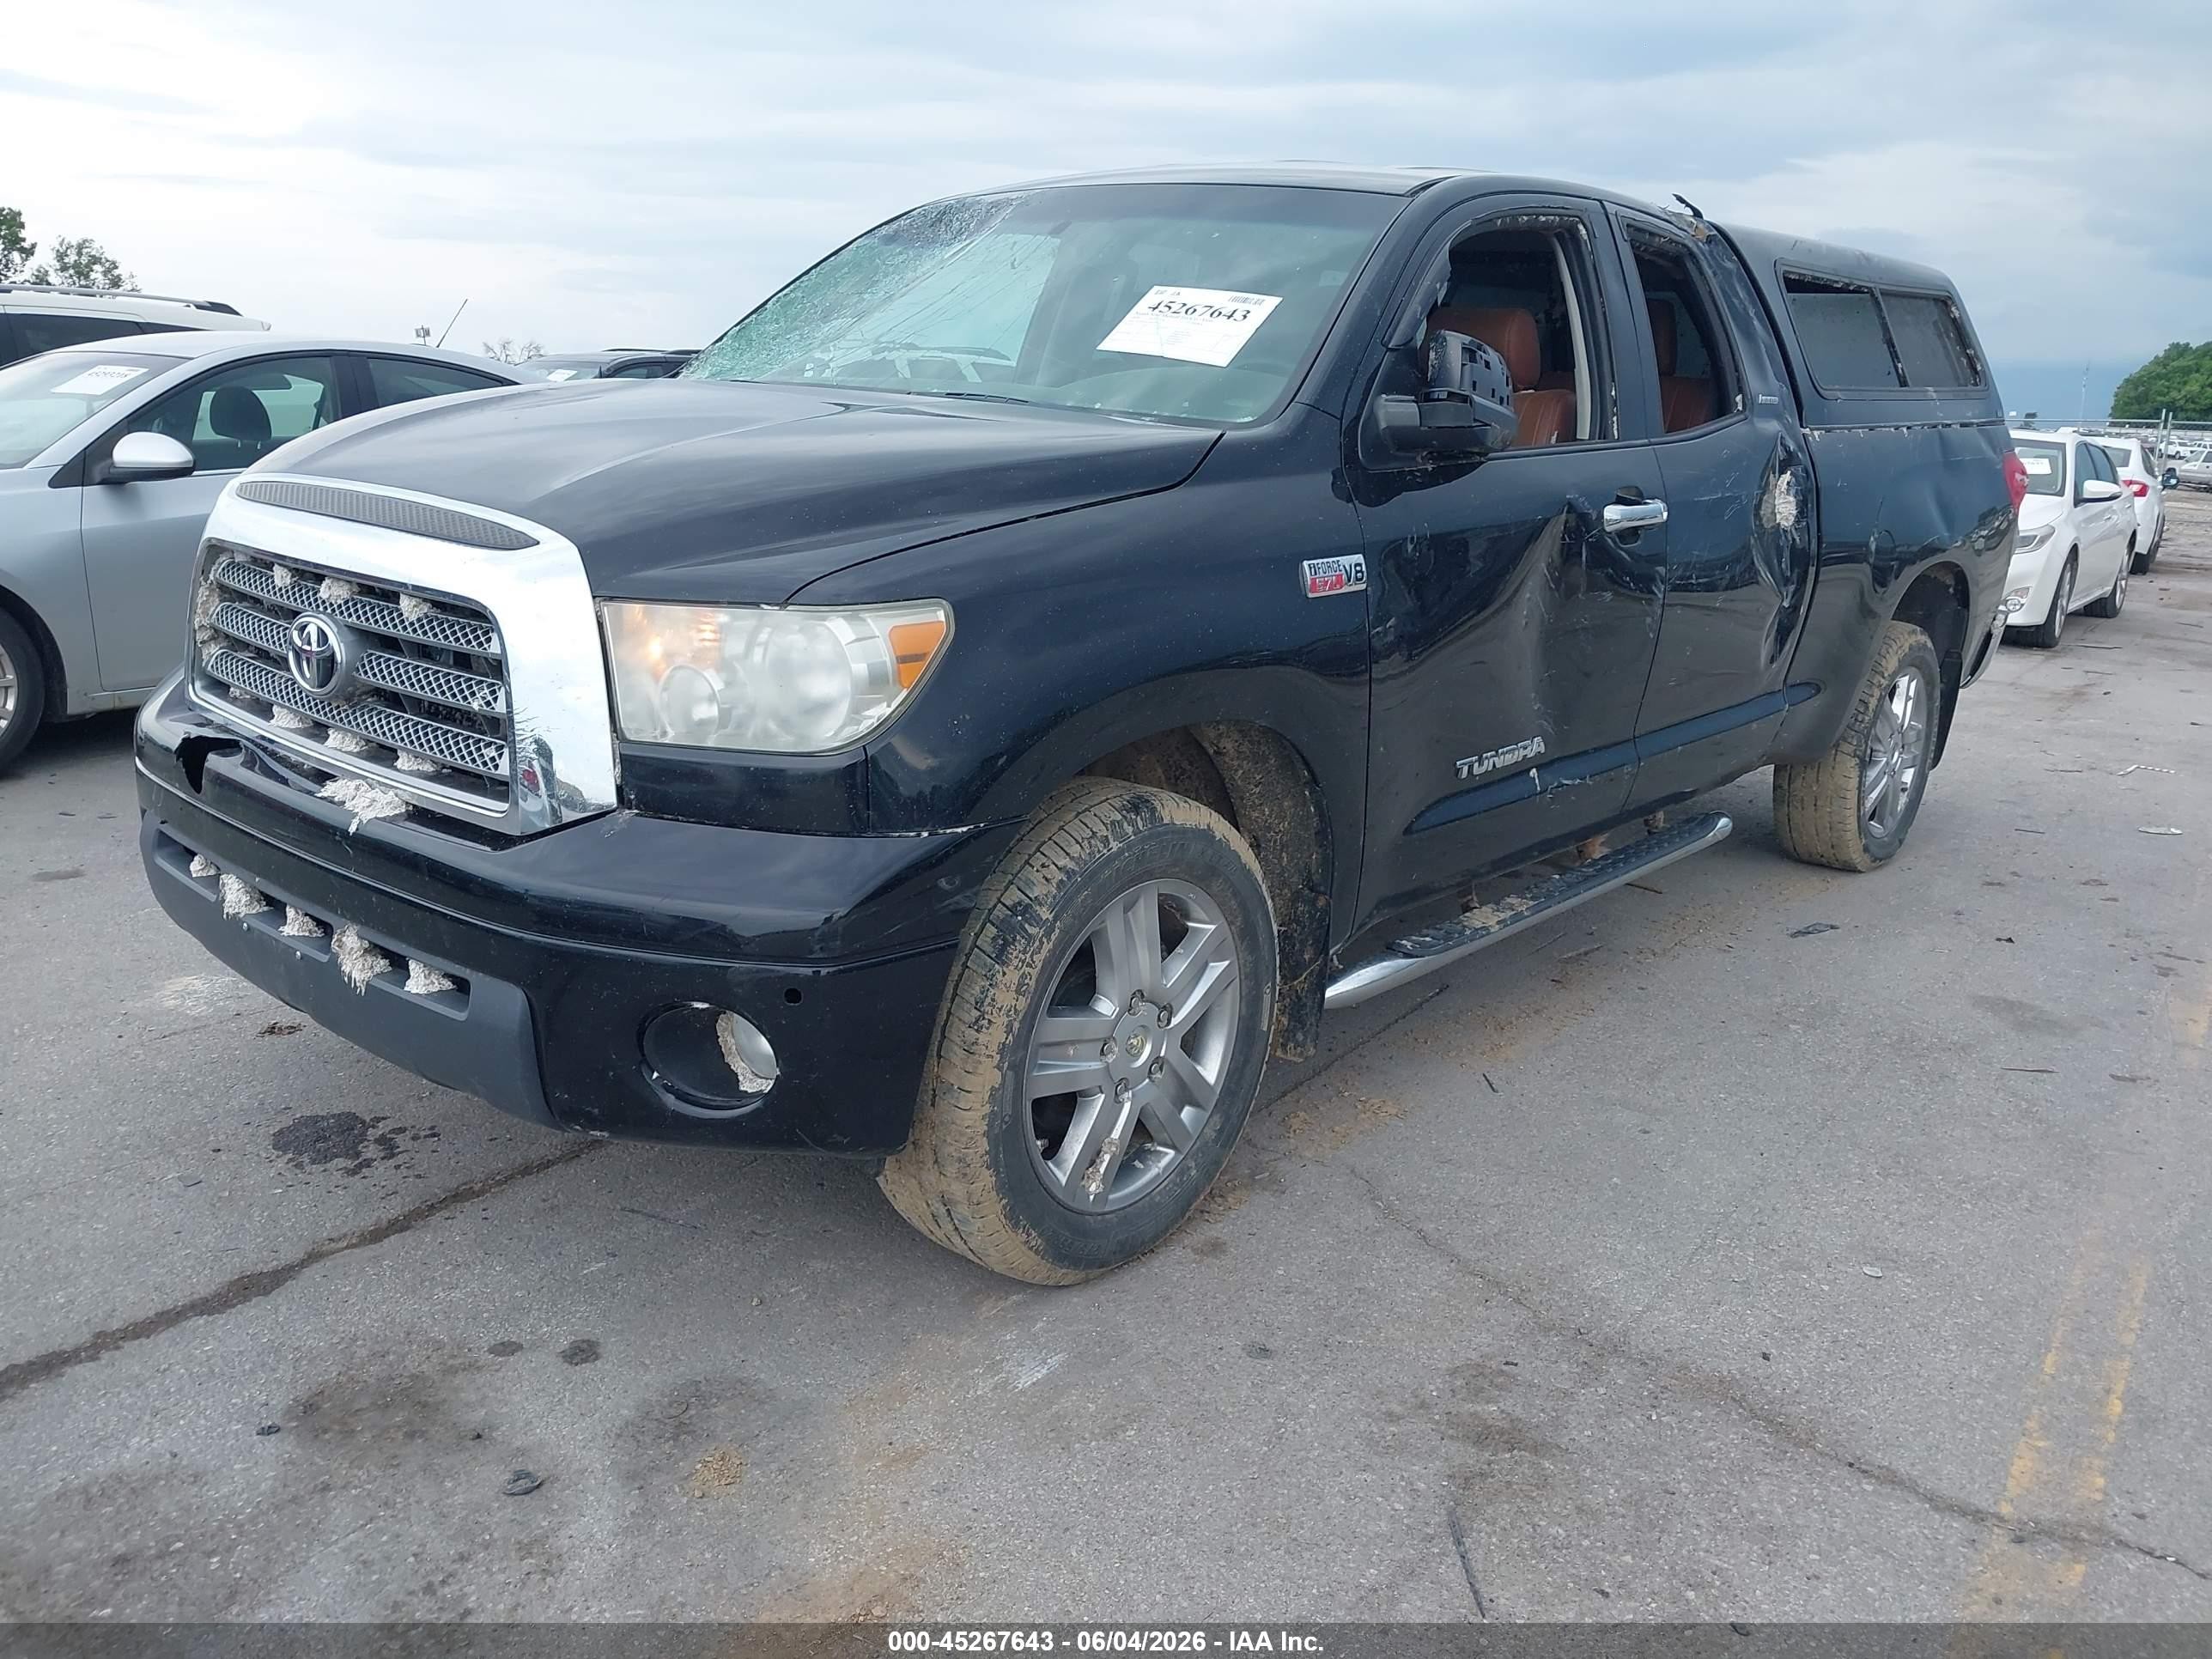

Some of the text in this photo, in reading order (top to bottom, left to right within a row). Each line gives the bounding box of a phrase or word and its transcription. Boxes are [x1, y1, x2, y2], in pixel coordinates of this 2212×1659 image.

[1147, 300, 1251, 322] 45267643
[1343, 562, 1365, 585] V8
[1455, 736, 1547, 779] TUNDRA
